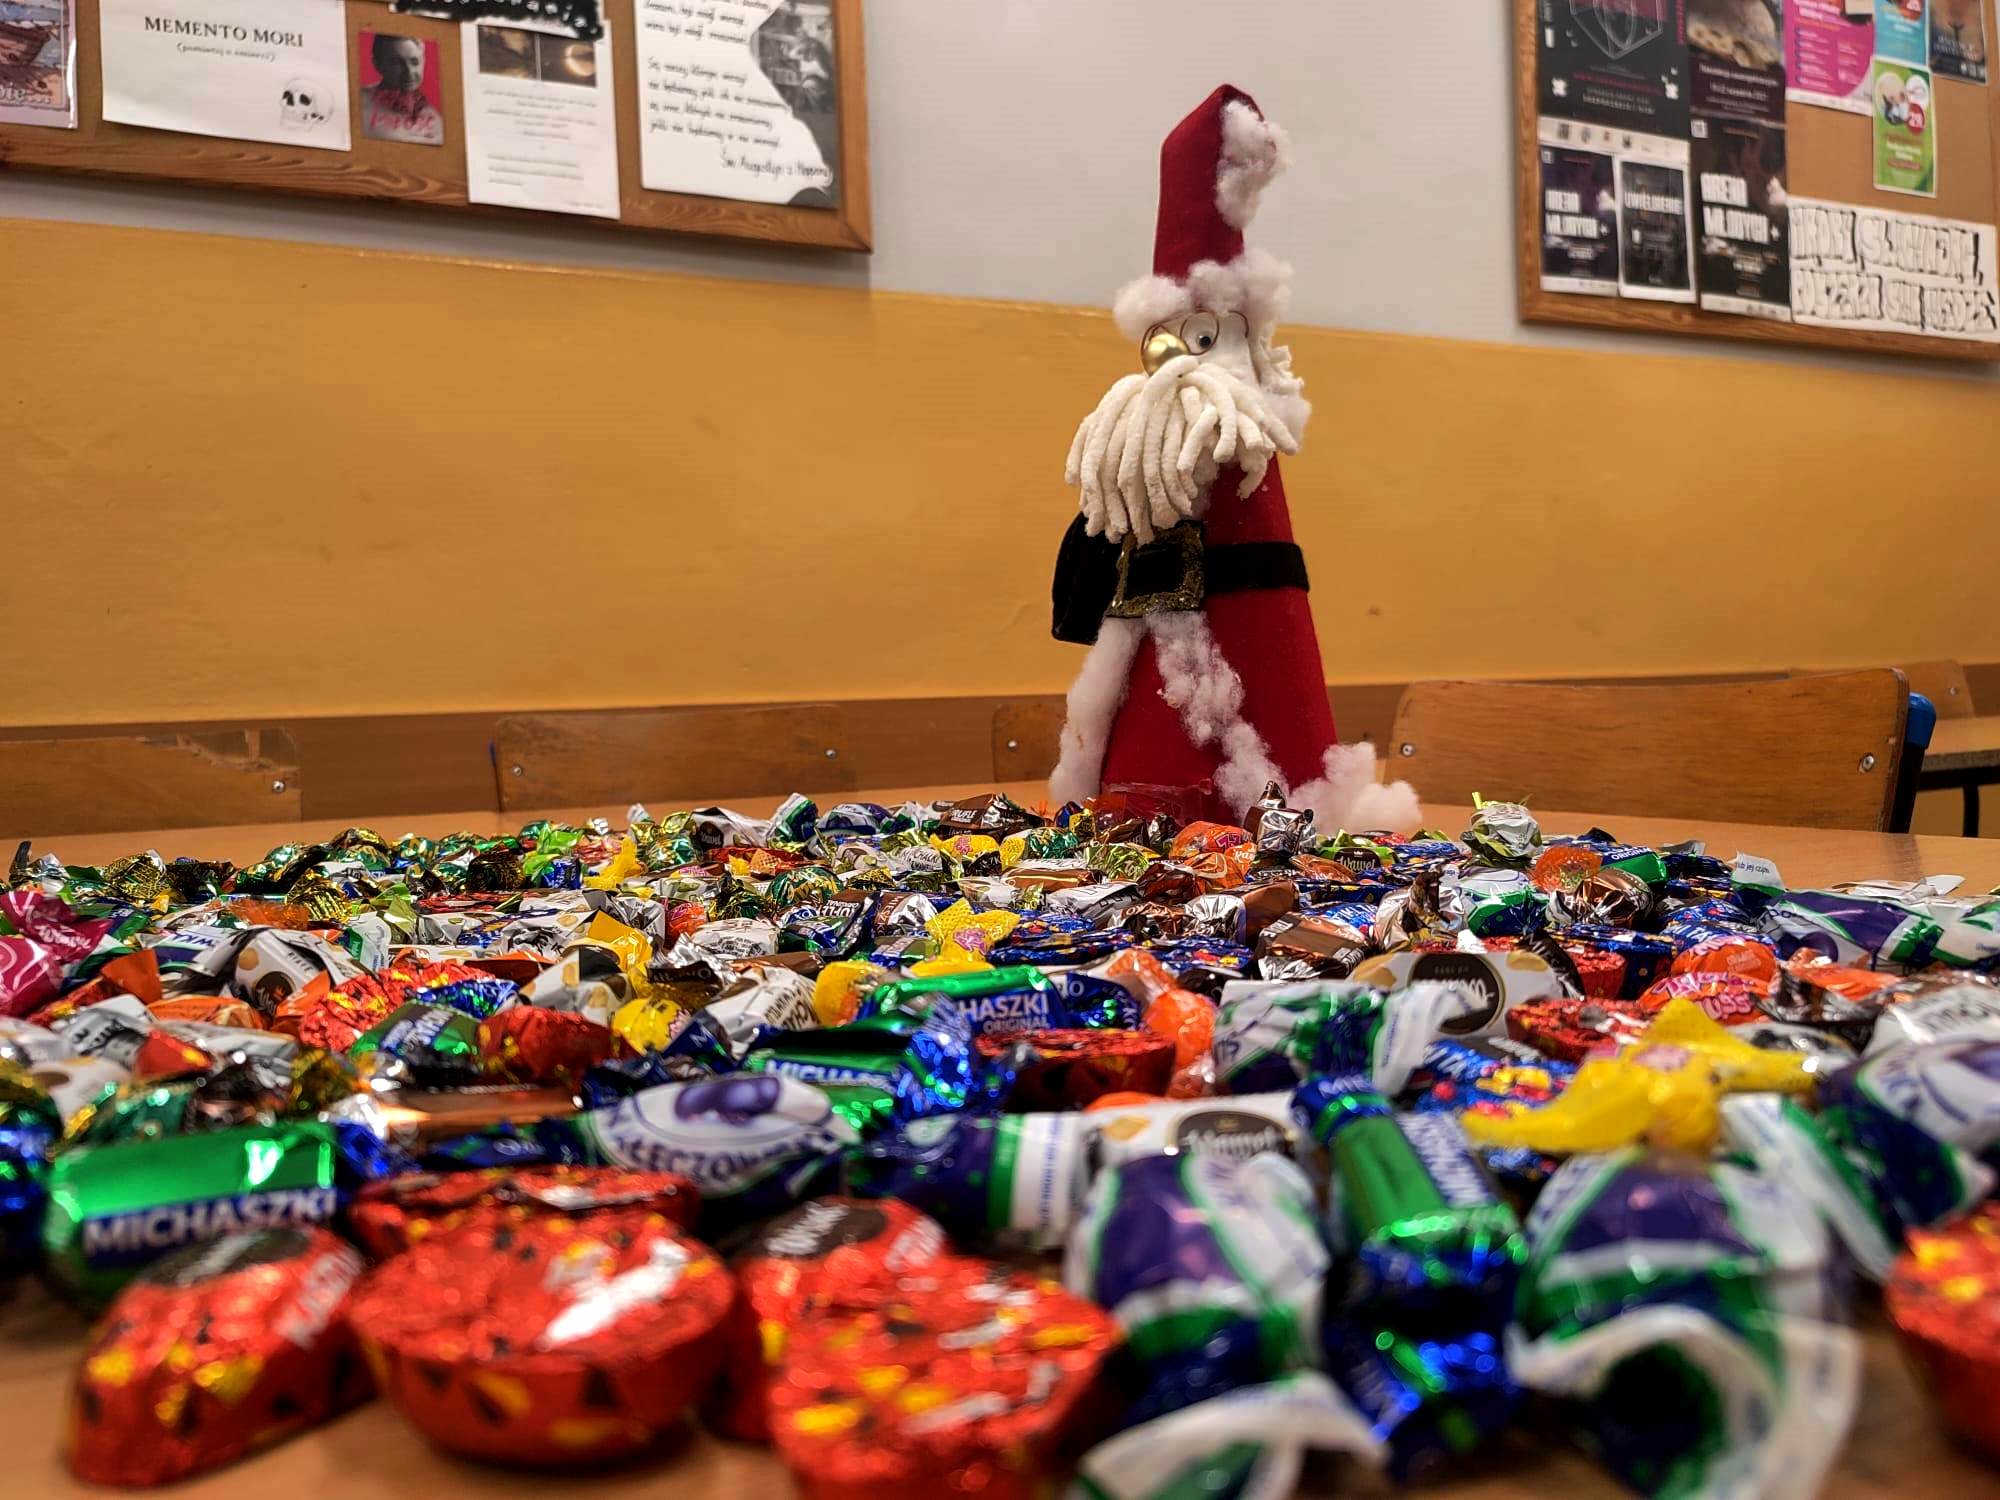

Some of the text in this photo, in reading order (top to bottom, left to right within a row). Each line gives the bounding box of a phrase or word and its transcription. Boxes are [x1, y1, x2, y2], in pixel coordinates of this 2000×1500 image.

[144, 16, 304, 48] MEMENTO MORI
[958, 992, 1049, 1022] HASZKI
[84, 1187, 337, 1255] MICHASZKI
